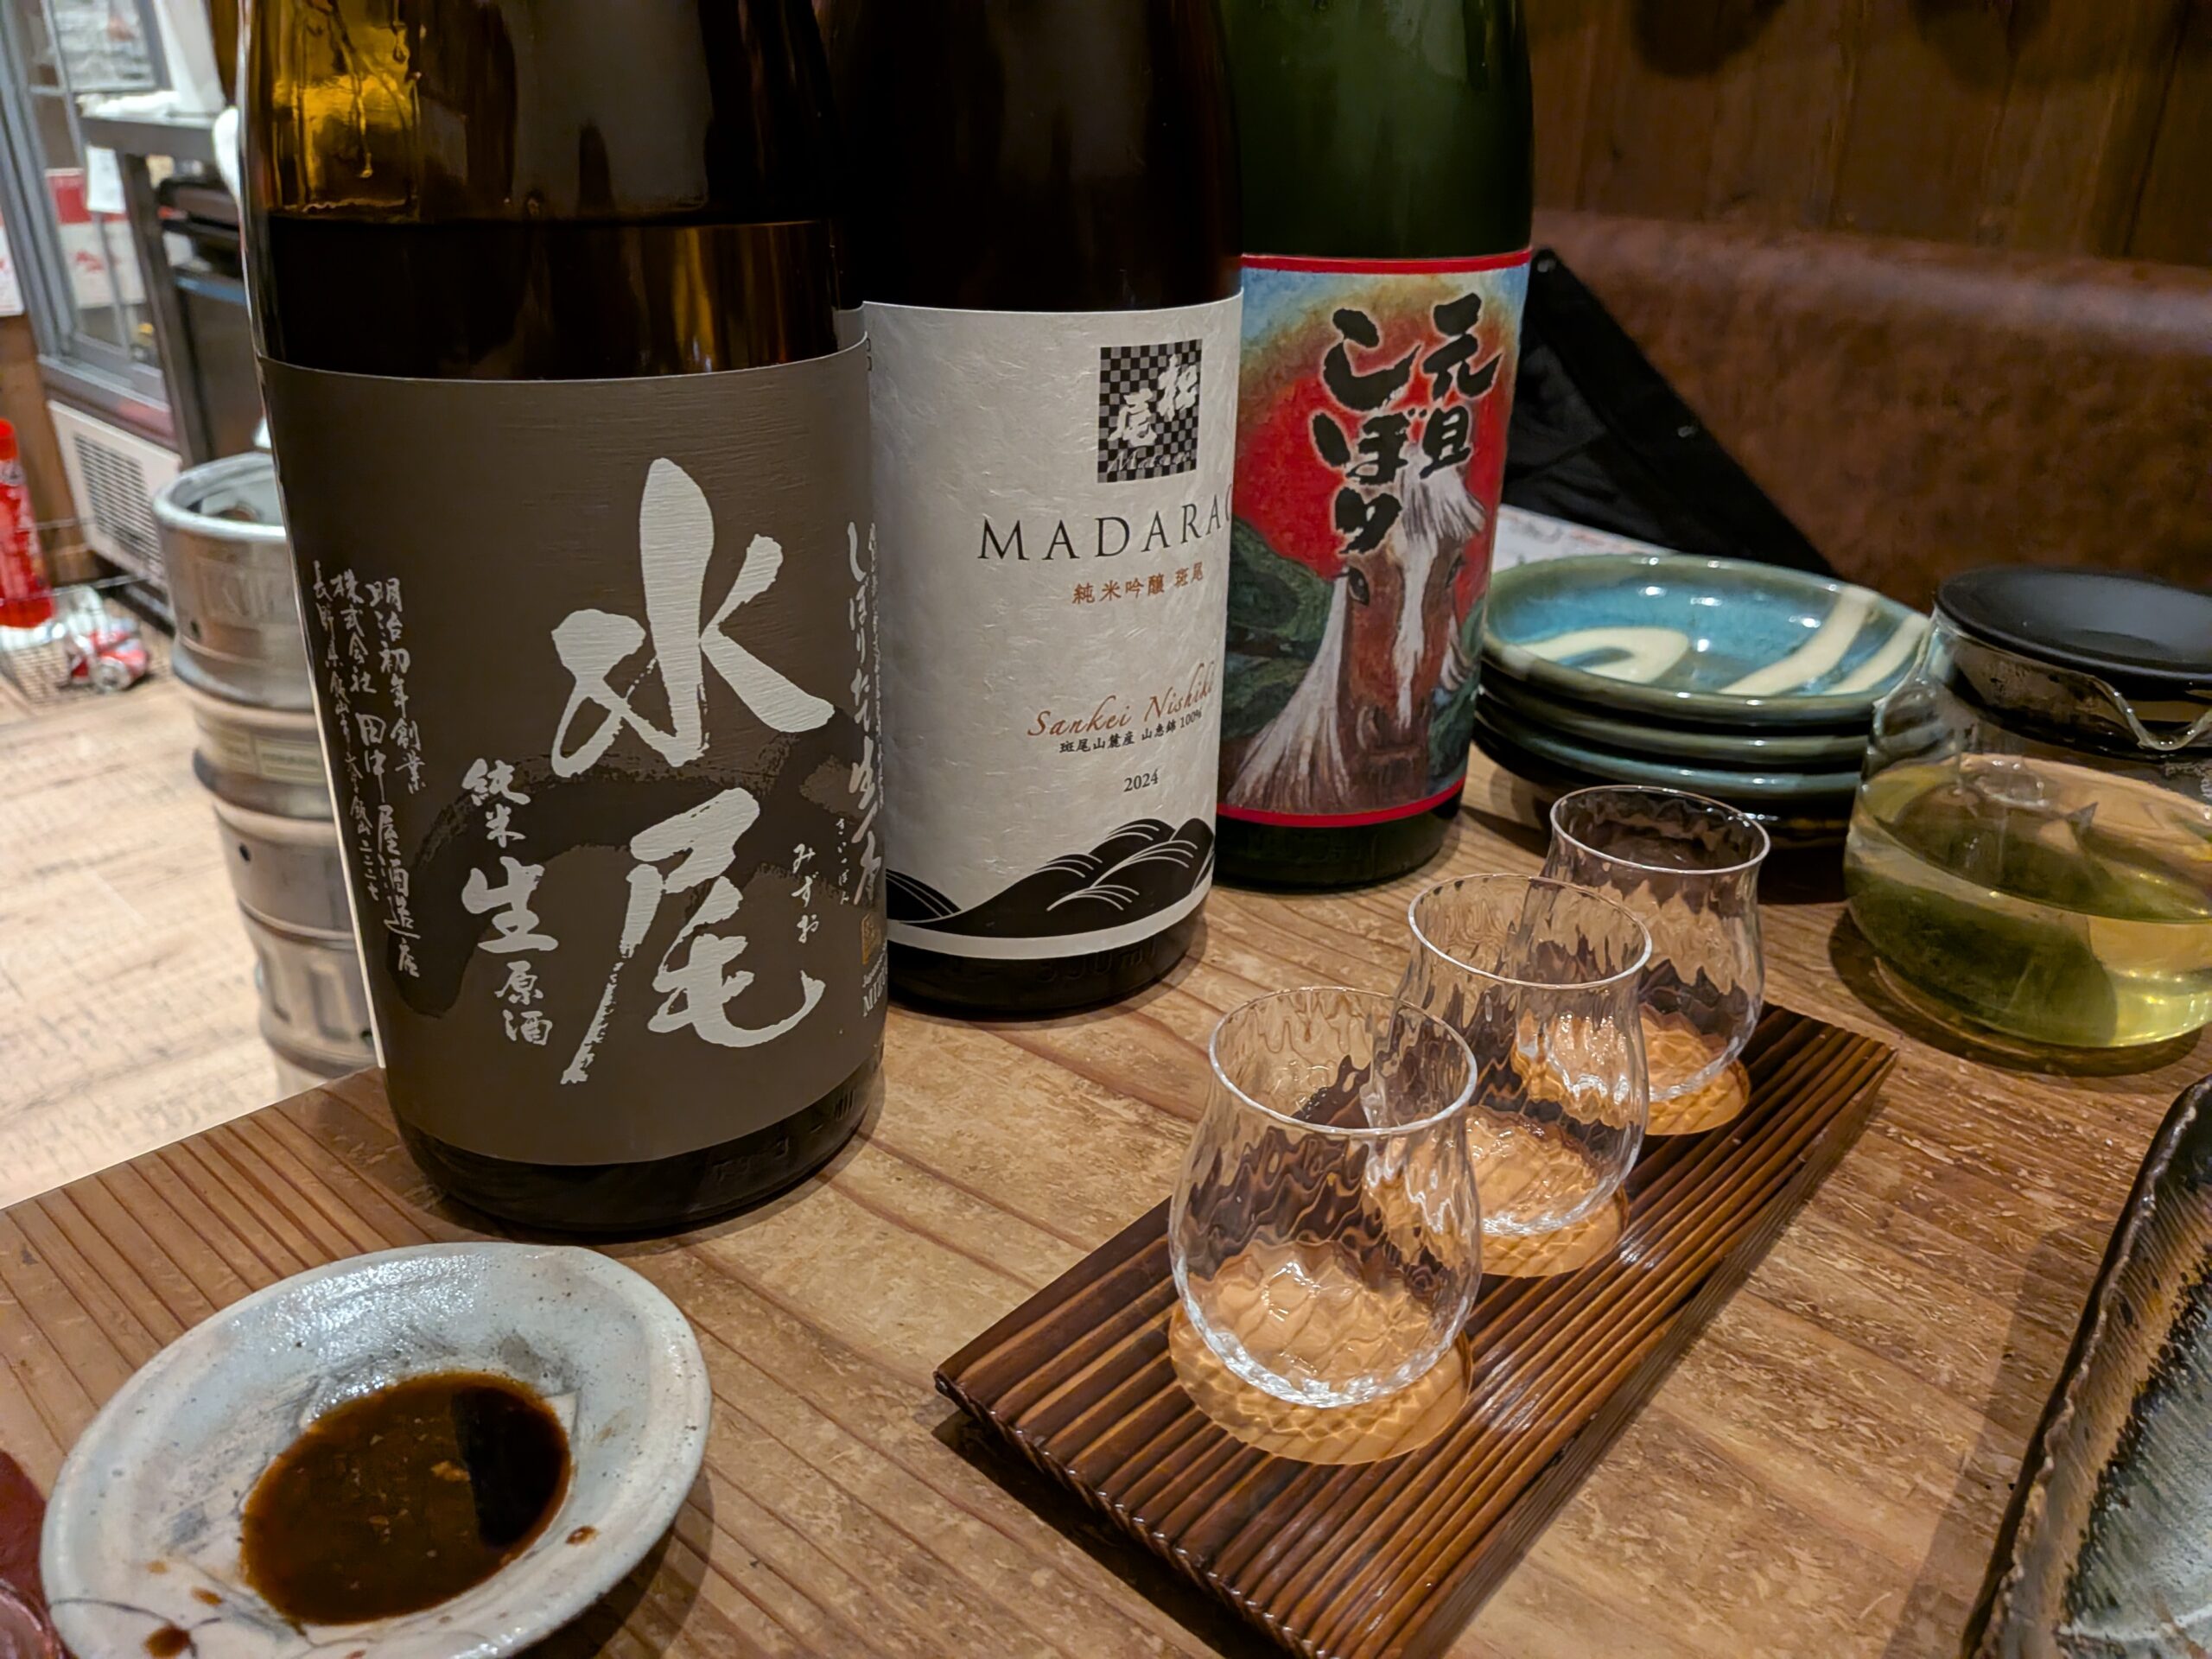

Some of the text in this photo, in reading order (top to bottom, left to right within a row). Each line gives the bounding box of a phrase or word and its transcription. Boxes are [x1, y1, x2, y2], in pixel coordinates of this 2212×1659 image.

[1072, 574, 1165, 605] 純米吟醸
[1027, 695, 1133, 736] Sankei
[1179, 708, 1203, 729] 100%
[550, 457, 835, 1086] 水尾
[1123, 768, 1159, 793] 2024
